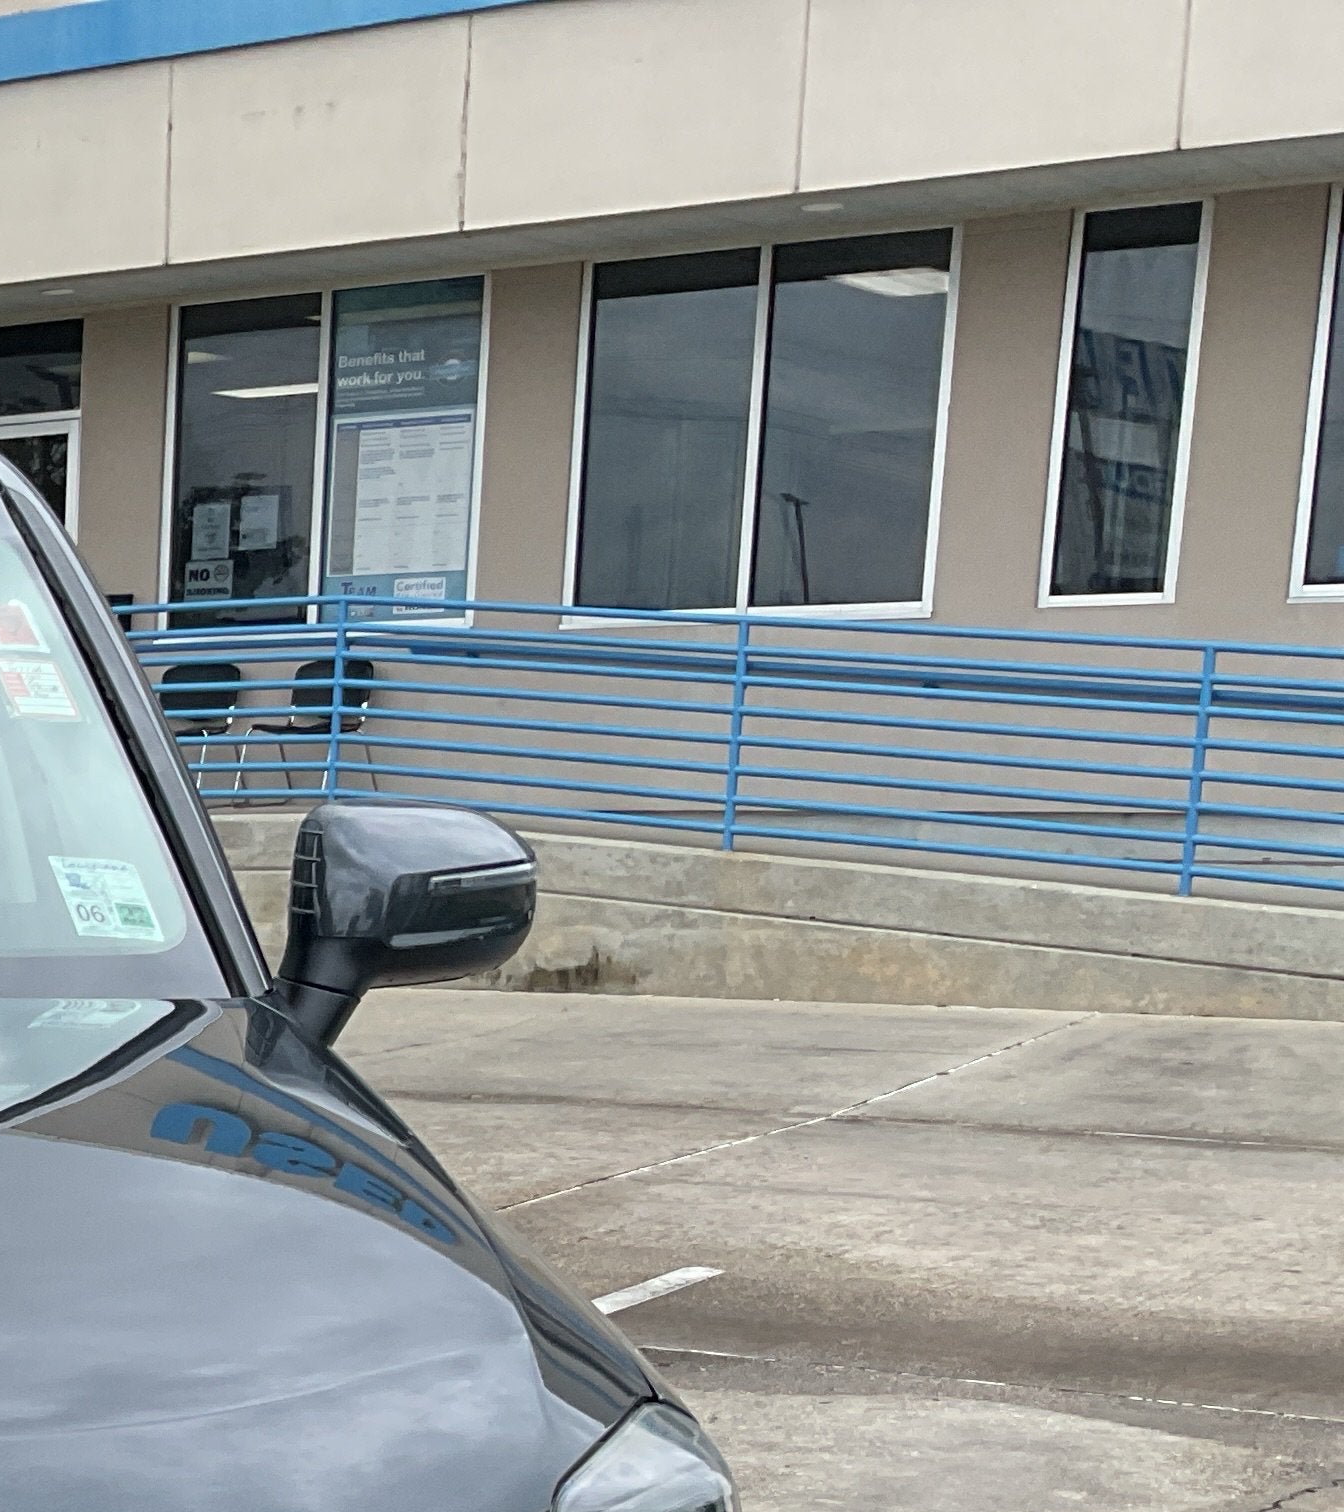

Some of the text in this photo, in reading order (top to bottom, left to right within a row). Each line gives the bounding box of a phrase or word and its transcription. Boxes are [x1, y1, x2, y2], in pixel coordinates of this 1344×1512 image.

[338, 349, 426, 369] Benefits that
[336, 372, 371, 387] work
[373, 371, 393, 385] for
[396, 370, 426, 385] you.
[188, 568, 211, 582] NO
[396, 579, 444, 592] Certified
[76, 904, 106, 923] 06
